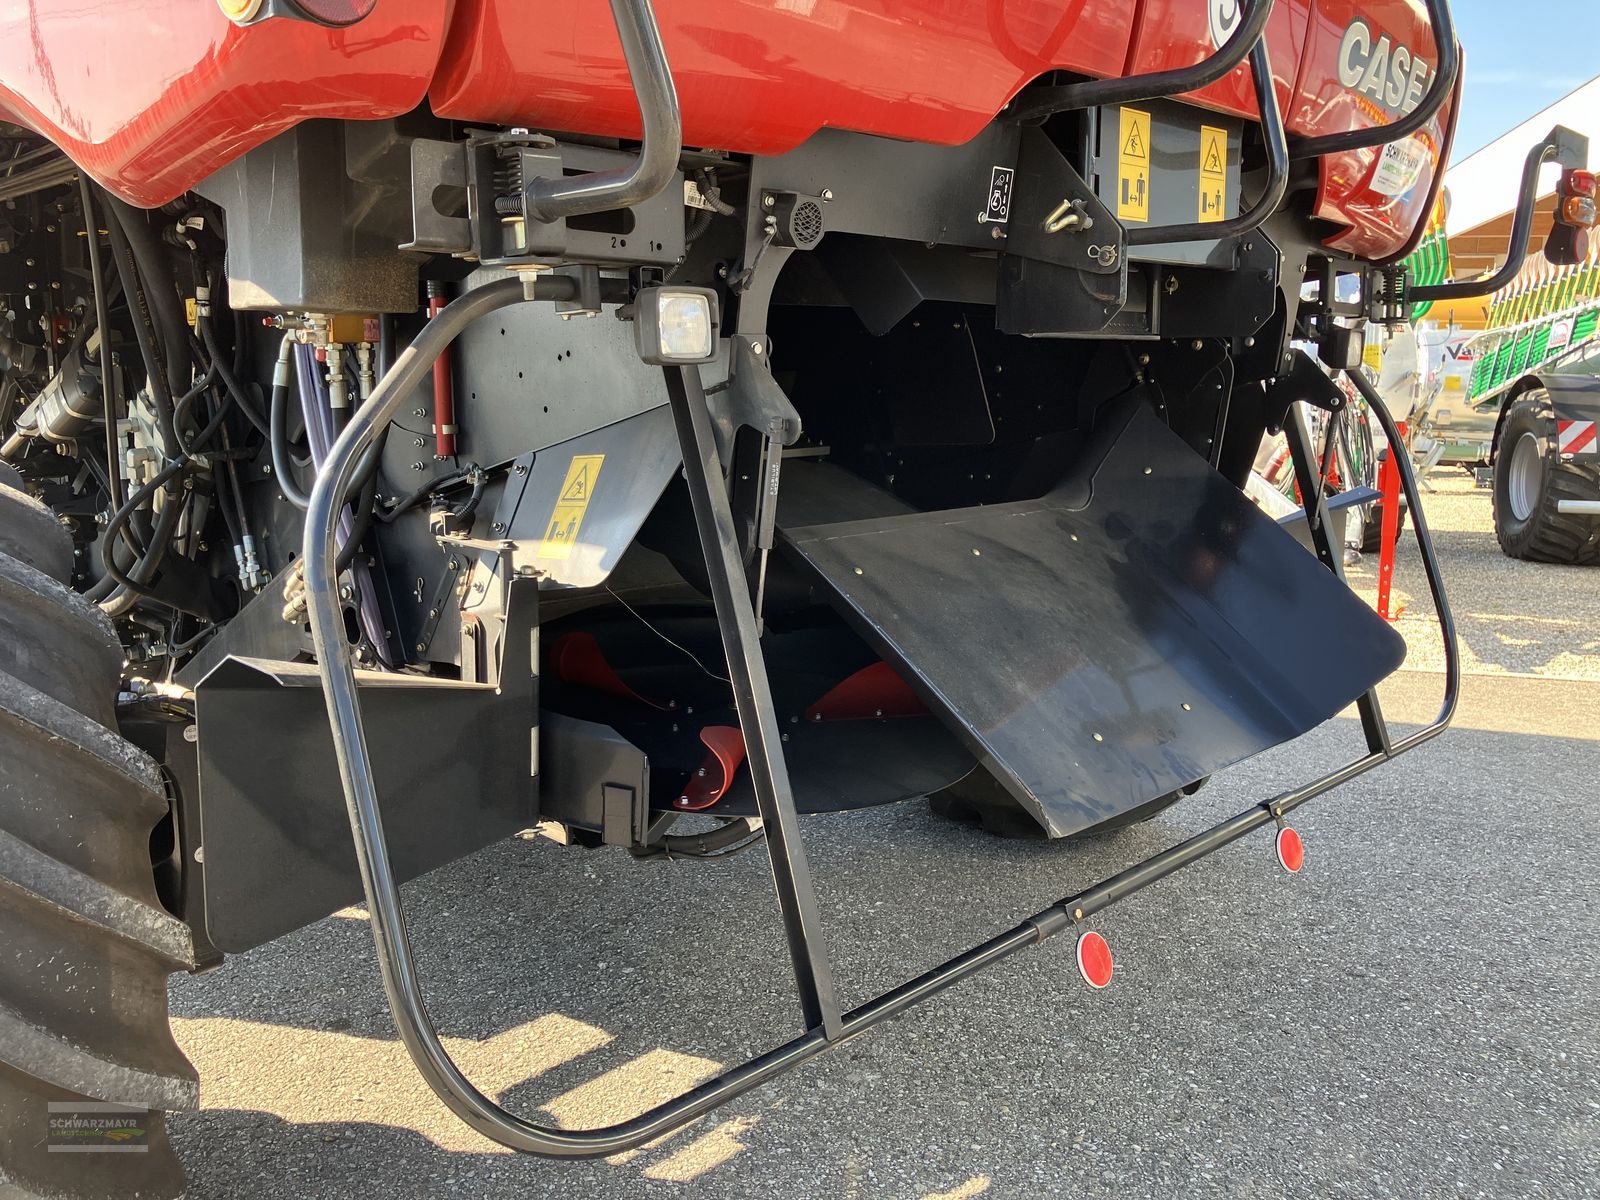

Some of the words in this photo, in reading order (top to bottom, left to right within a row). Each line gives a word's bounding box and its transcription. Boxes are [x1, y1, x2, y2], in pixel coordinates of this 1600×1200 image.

[1338, 20, 1428, 114] CASE
[611, 236, 617, 249] 2
[649, 240, 654, 252] 1
